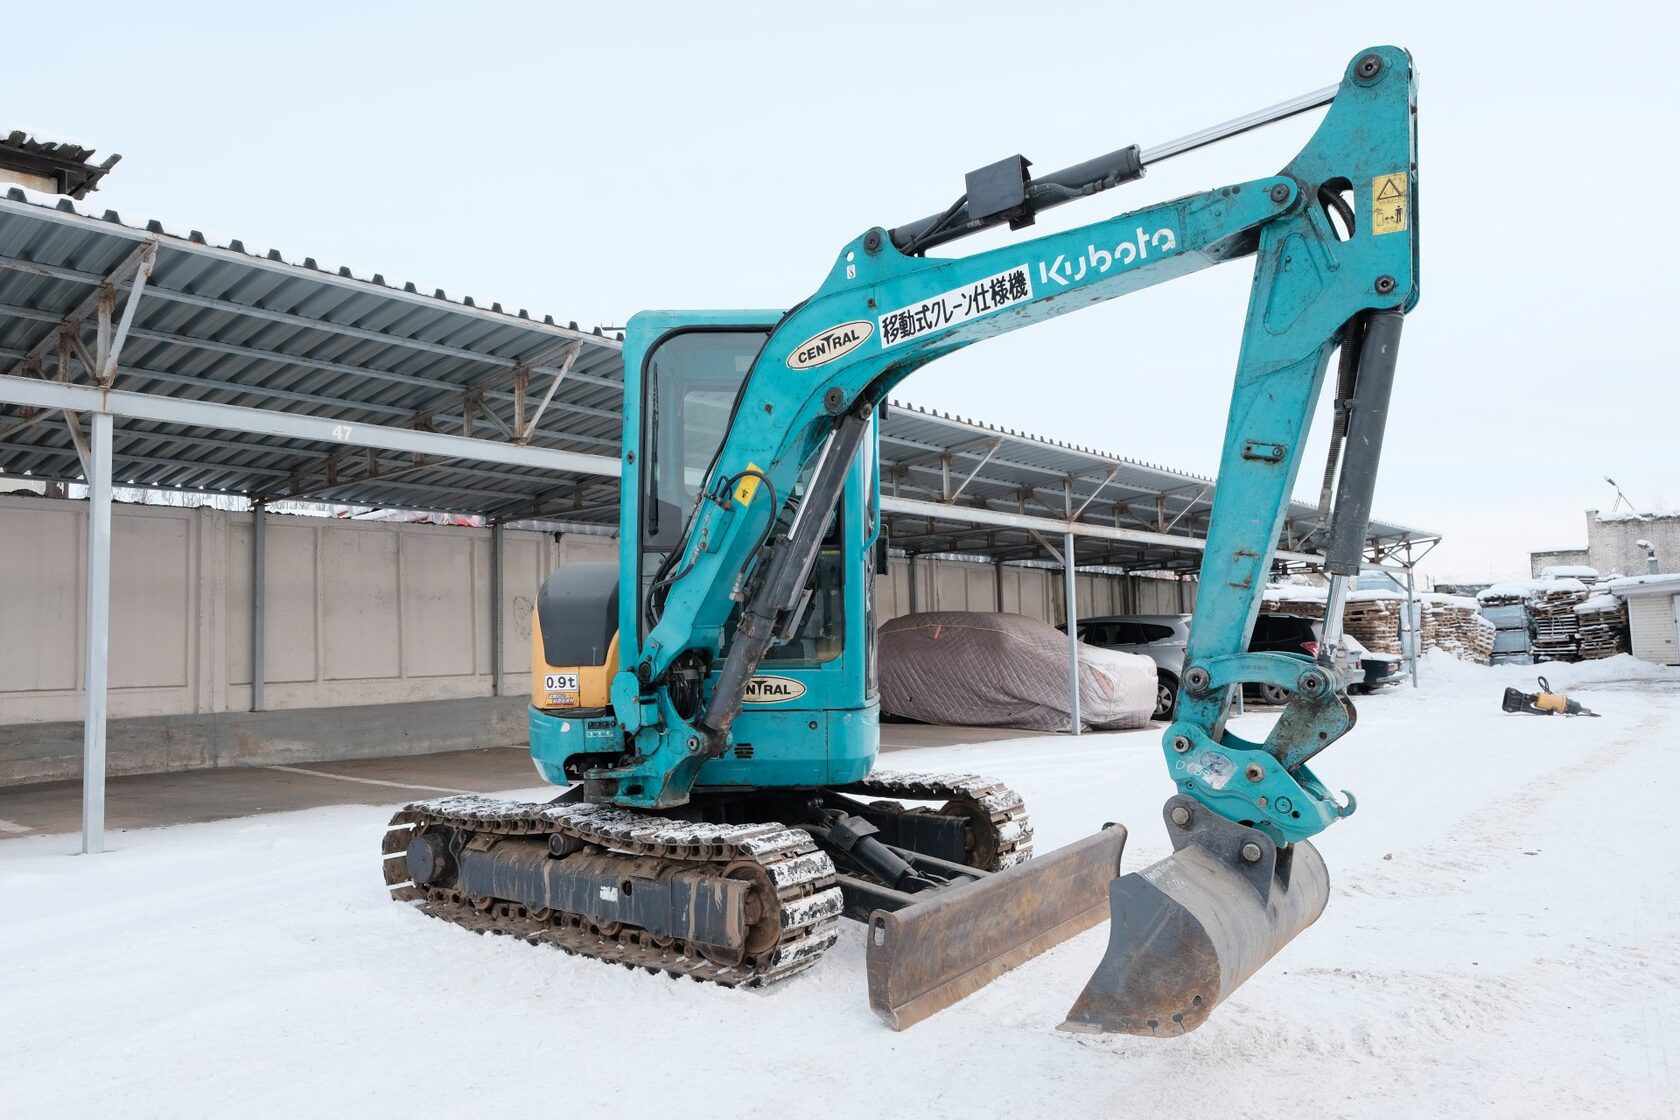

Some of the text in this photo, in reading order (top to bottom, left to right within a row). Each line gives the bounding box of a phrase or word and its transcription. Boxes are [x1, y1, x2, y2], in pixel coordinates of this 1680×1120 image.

[1038, 227, 1176, 286] Kubota
[881, 269, 1028, 345] 移動式クレーン仕様機
[797, 329, 860, 363] CENTRAL
[332, 424, 353, 441] 47
[745, 680, 791, 696] NTRAL
